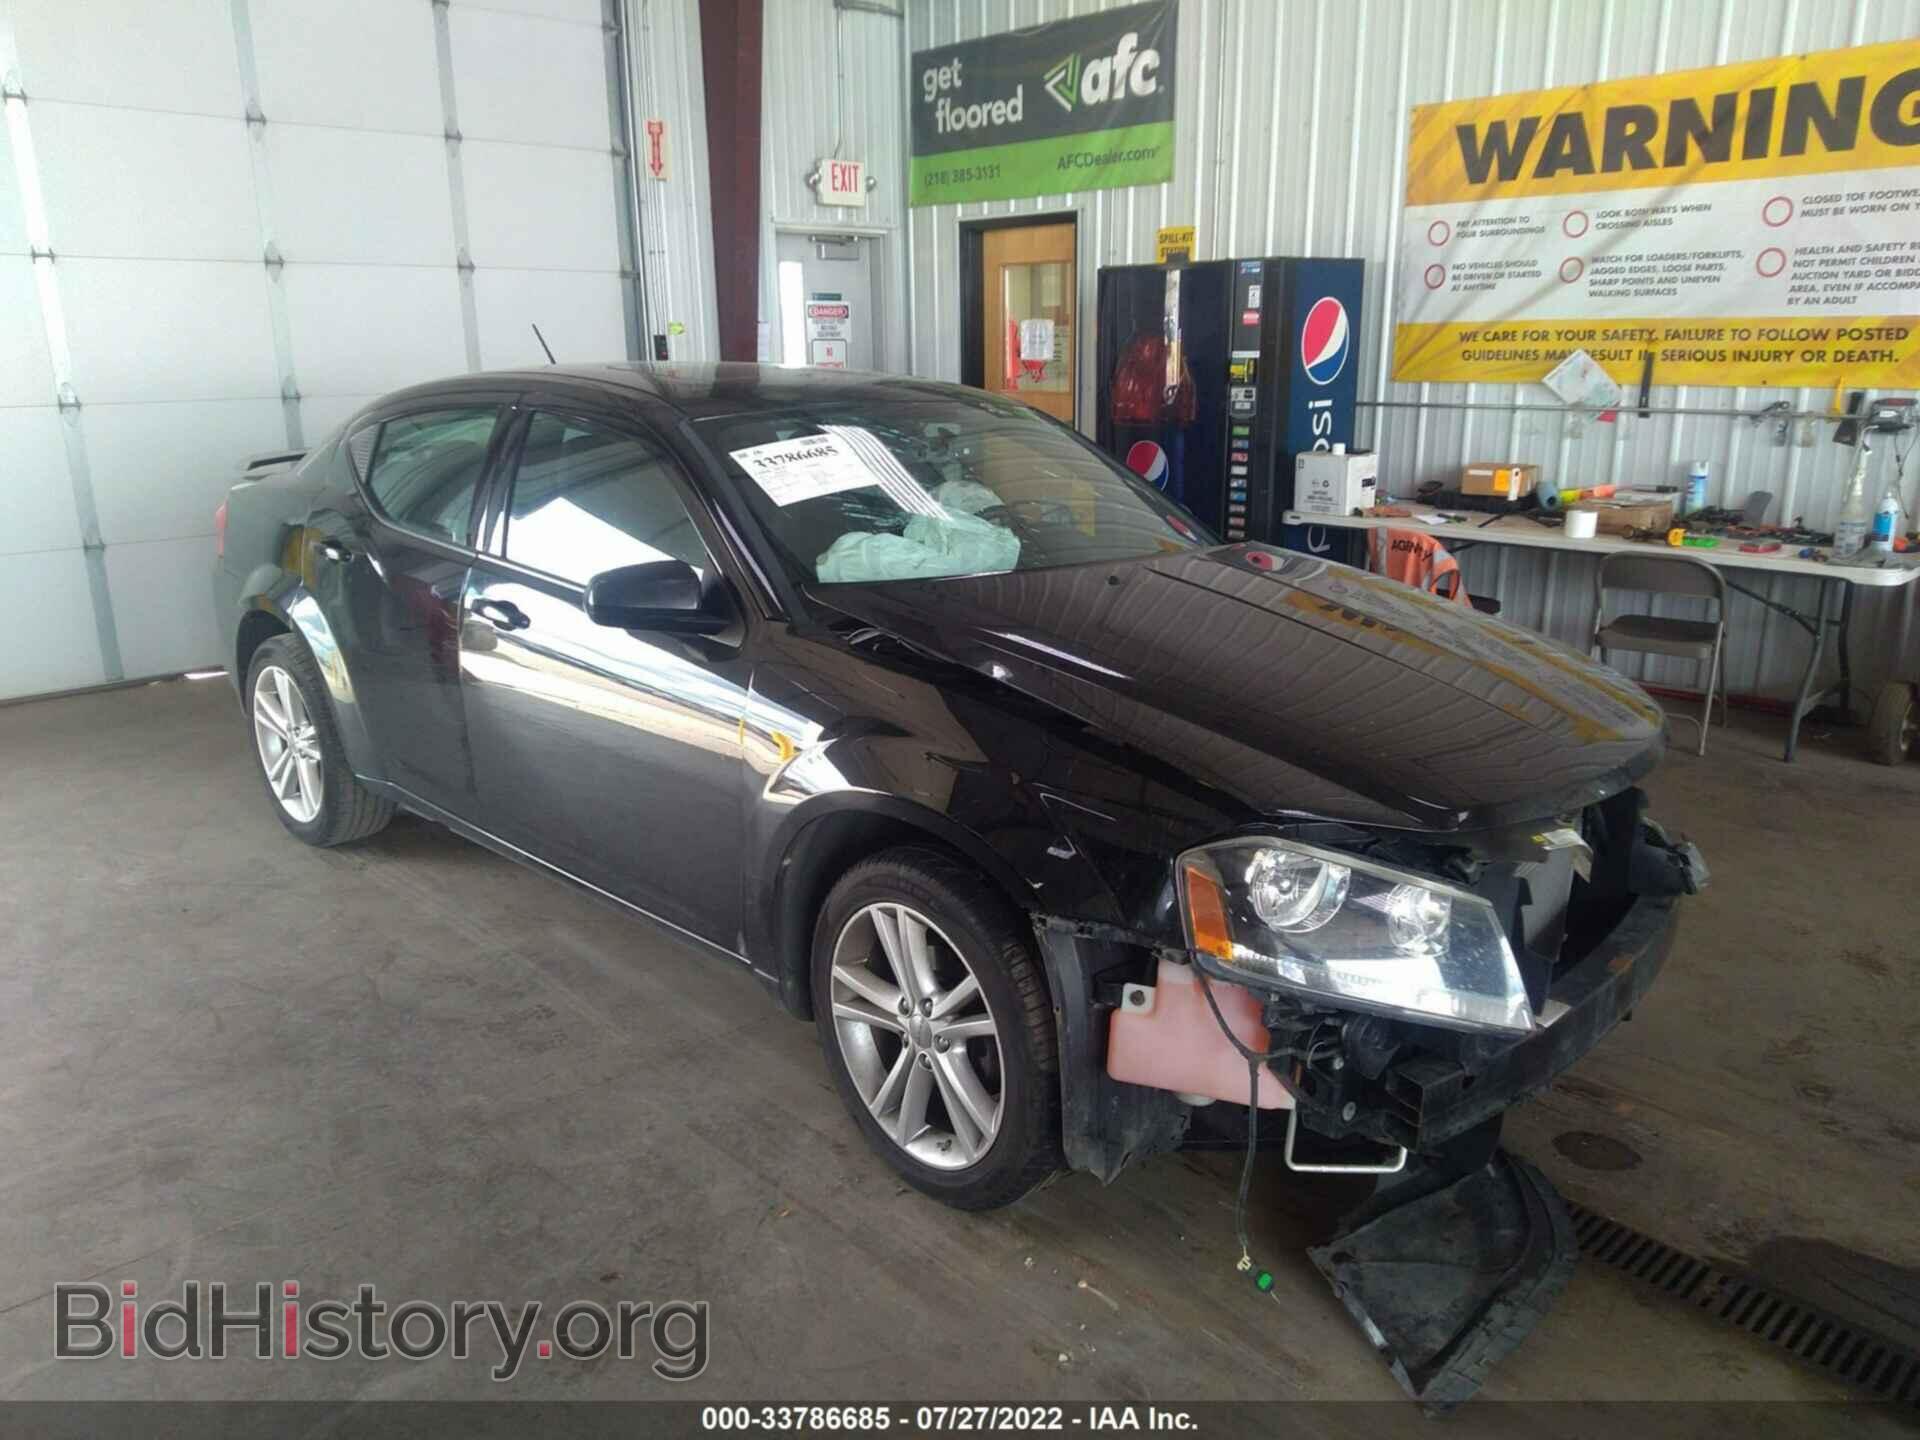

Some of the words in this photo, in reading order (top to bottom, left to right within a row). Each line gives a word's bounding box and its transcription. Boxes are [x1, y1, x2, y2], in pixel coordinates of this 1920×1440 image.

[1081, 31, 1161, 106] afc
[923, 57, 962, 101] get
[935, 84, 1024, 134] floored
[1456, 66, 1920, 185] WARNING
[1057, 146, 1155, 171] AFCDealer.com
[831, 160, 859, 192] EXIT
[1802, 194, 1841, 205] CLOSED
[1846, 192, 1865, 202] TOE
[1596, 210, 1622, 219] LOOK
[1681, 204, 1712, 213] WHEN
[1801, 208, 1830, 217] MUST
[1833, 207, 1845, 216] BE
[1849, 204, 1886, 214] WORN
[1890, 203, 1909, 212] ON
[1472, 217, 1516, 226] ATTENTION
[1519, 216, 1530, 224] TO
[1643, 218, 1673, 227] AISLES
[1795, 246, 1834, 255] HEALTH
[1838, 244, 1862, 253] AND
[1865, 242, 1905, 252] SAFETY
[1591, 255, 1623, 263] WATCH
[1625, 254, 1644, 262] FOR
[1793, 260, 1815, 268] NOT
[1818, 258, 1856, 267] PERMIT
[1859, 255, 1915, 266] CHILDREN
[1507, 270, 1542, 279] STARTED
[1590, 266, 1625, 275] JAGGED
[1663, 264, 1692, 273] LOOSE
[1792, 271, 1839, 281] AUCTION
[1843, 269, 1871, 279] YARD
[1874, 268, 1892, 278] OR
[1590, 278, 1619, 286] SHARP
[1621, 277, 1655, 286] POINTS
[1657, 276, 1678, 284] AND
[1681, 275, 1720, 284] UNEVEN
[1589, 289, 1631, 297] WALKING
[1634, 287, 1677, 297] SURFACES
[1790, 284, 1819, 293] AREA,
[1823, 283, 1850, 292] EVEN
[1854, 282, 1864, 291] IF
[1787, 297, 1801, 305] BY
[1804, 296, 1821, 305] AN
[1823, 295, 1857, 305] ADULT
[1459, 330, 1479, 342] WE
[1483, 330, 1517, 342] CARE
[1522, 329, 1549, 342] FOR
[1555, 329, 1596, 342] YOUR
[1602, 328, 1658, 341] SAFETY.
[1664, 328, 1725, 341] FAILURE
[1731, 328, 1751, 341] TO
[1756, 328, 1830, 341] FOLLOW
[1836, 327, 1909, 341] POSTED
[1462, 349, 1539, 361] GUIDELINES
[1661, 349, 1727, 362] SERIOUS
[1733, 349, 1793, 362] INJURY
[1801, 349, 1826, 362] OR
[1833, 349, 1899, 363] DEATH.
